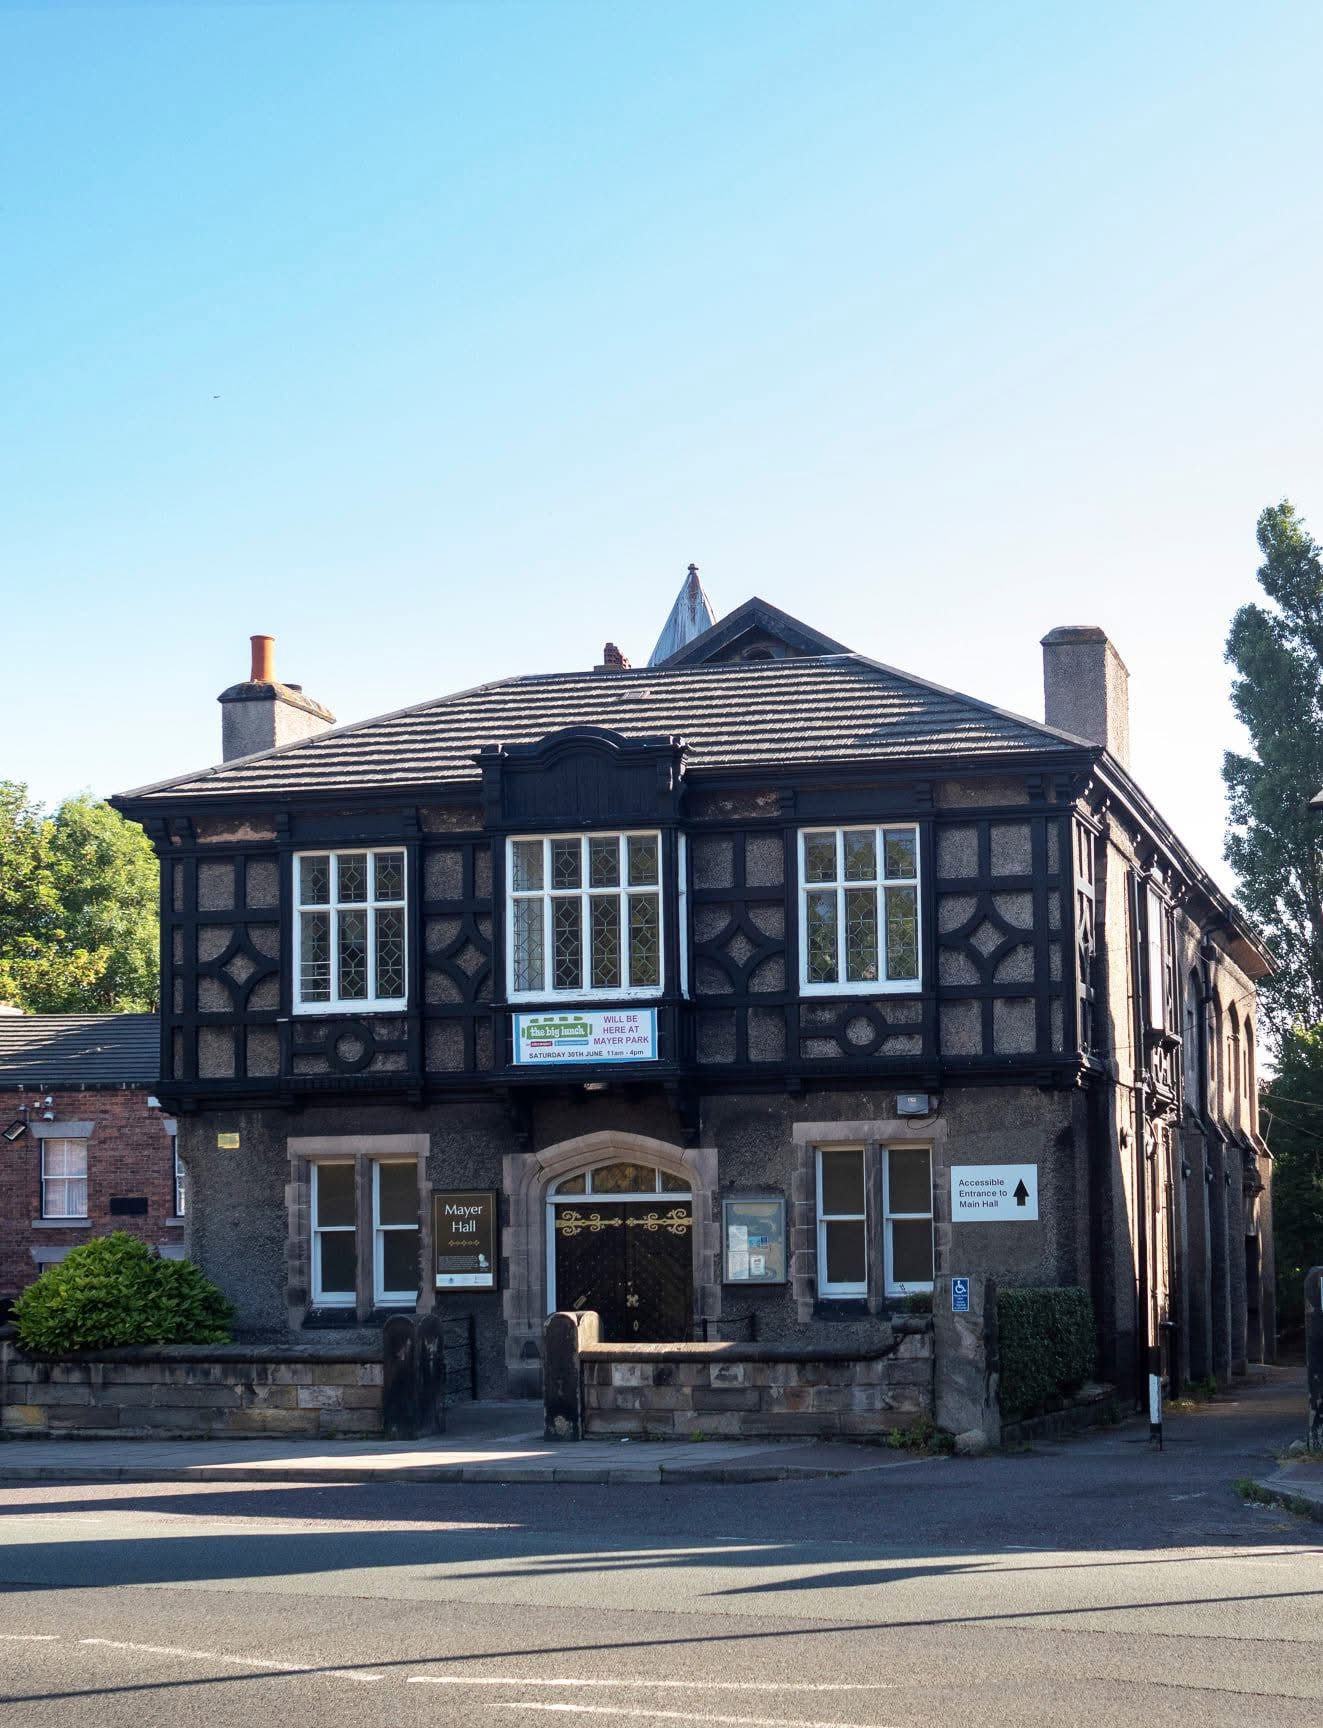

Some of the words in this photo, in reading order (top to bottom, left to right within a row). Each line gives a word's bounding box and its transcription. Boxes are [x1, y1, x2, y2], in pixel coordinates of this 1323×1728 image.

[530, 1026, 546, 1036] the
[546, 1026, 560, 1038] big
[444, 1204, 482, 1218] Mayer
[452, 1220, 476, 1232] Hall
